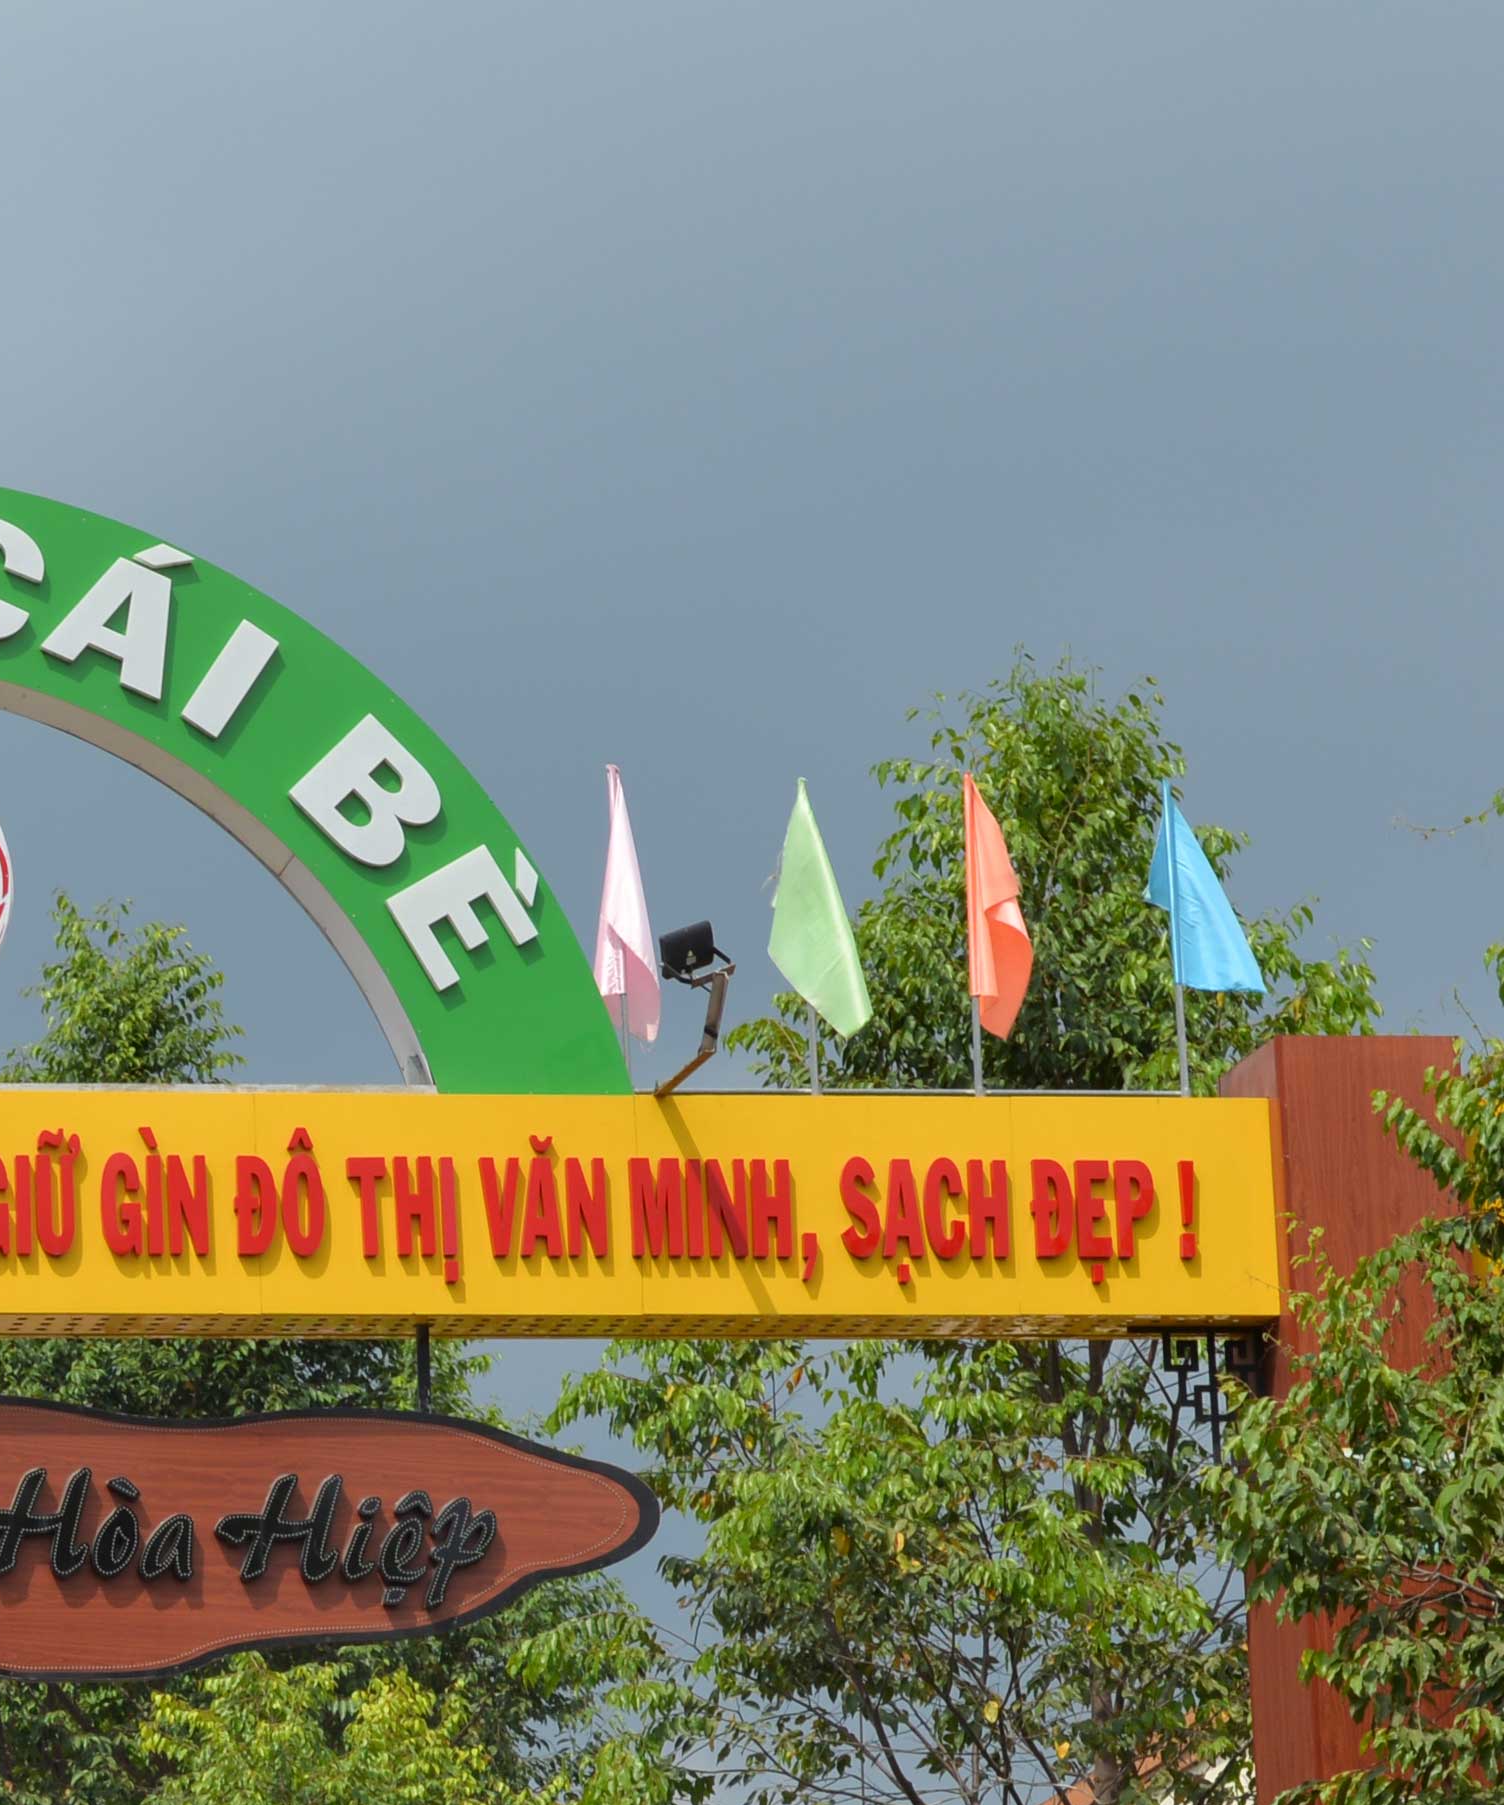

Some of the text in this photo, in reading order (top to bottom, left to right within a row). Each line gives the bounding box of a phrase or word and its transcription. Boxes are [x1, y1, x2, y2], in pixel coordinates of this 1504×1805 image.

[290, 712, 540, 992] BÈ
[101, 1126, 209, 1257] GÌN
[234, 1126, 325, 1259] ĐÔ
[346, 1154, 461, 1285] THỊ
[478, 1133, 607, 1258] VĂN
[628, 1157, 819, 1283] MINH,
[840, 1156, 1009, 1285] SẠCH
[1030, 1158, 1154, 1285] ĐẸP
[1177, 1160, 1196, 1261] !
[214, 1473, 497, 1608] Hiệp
